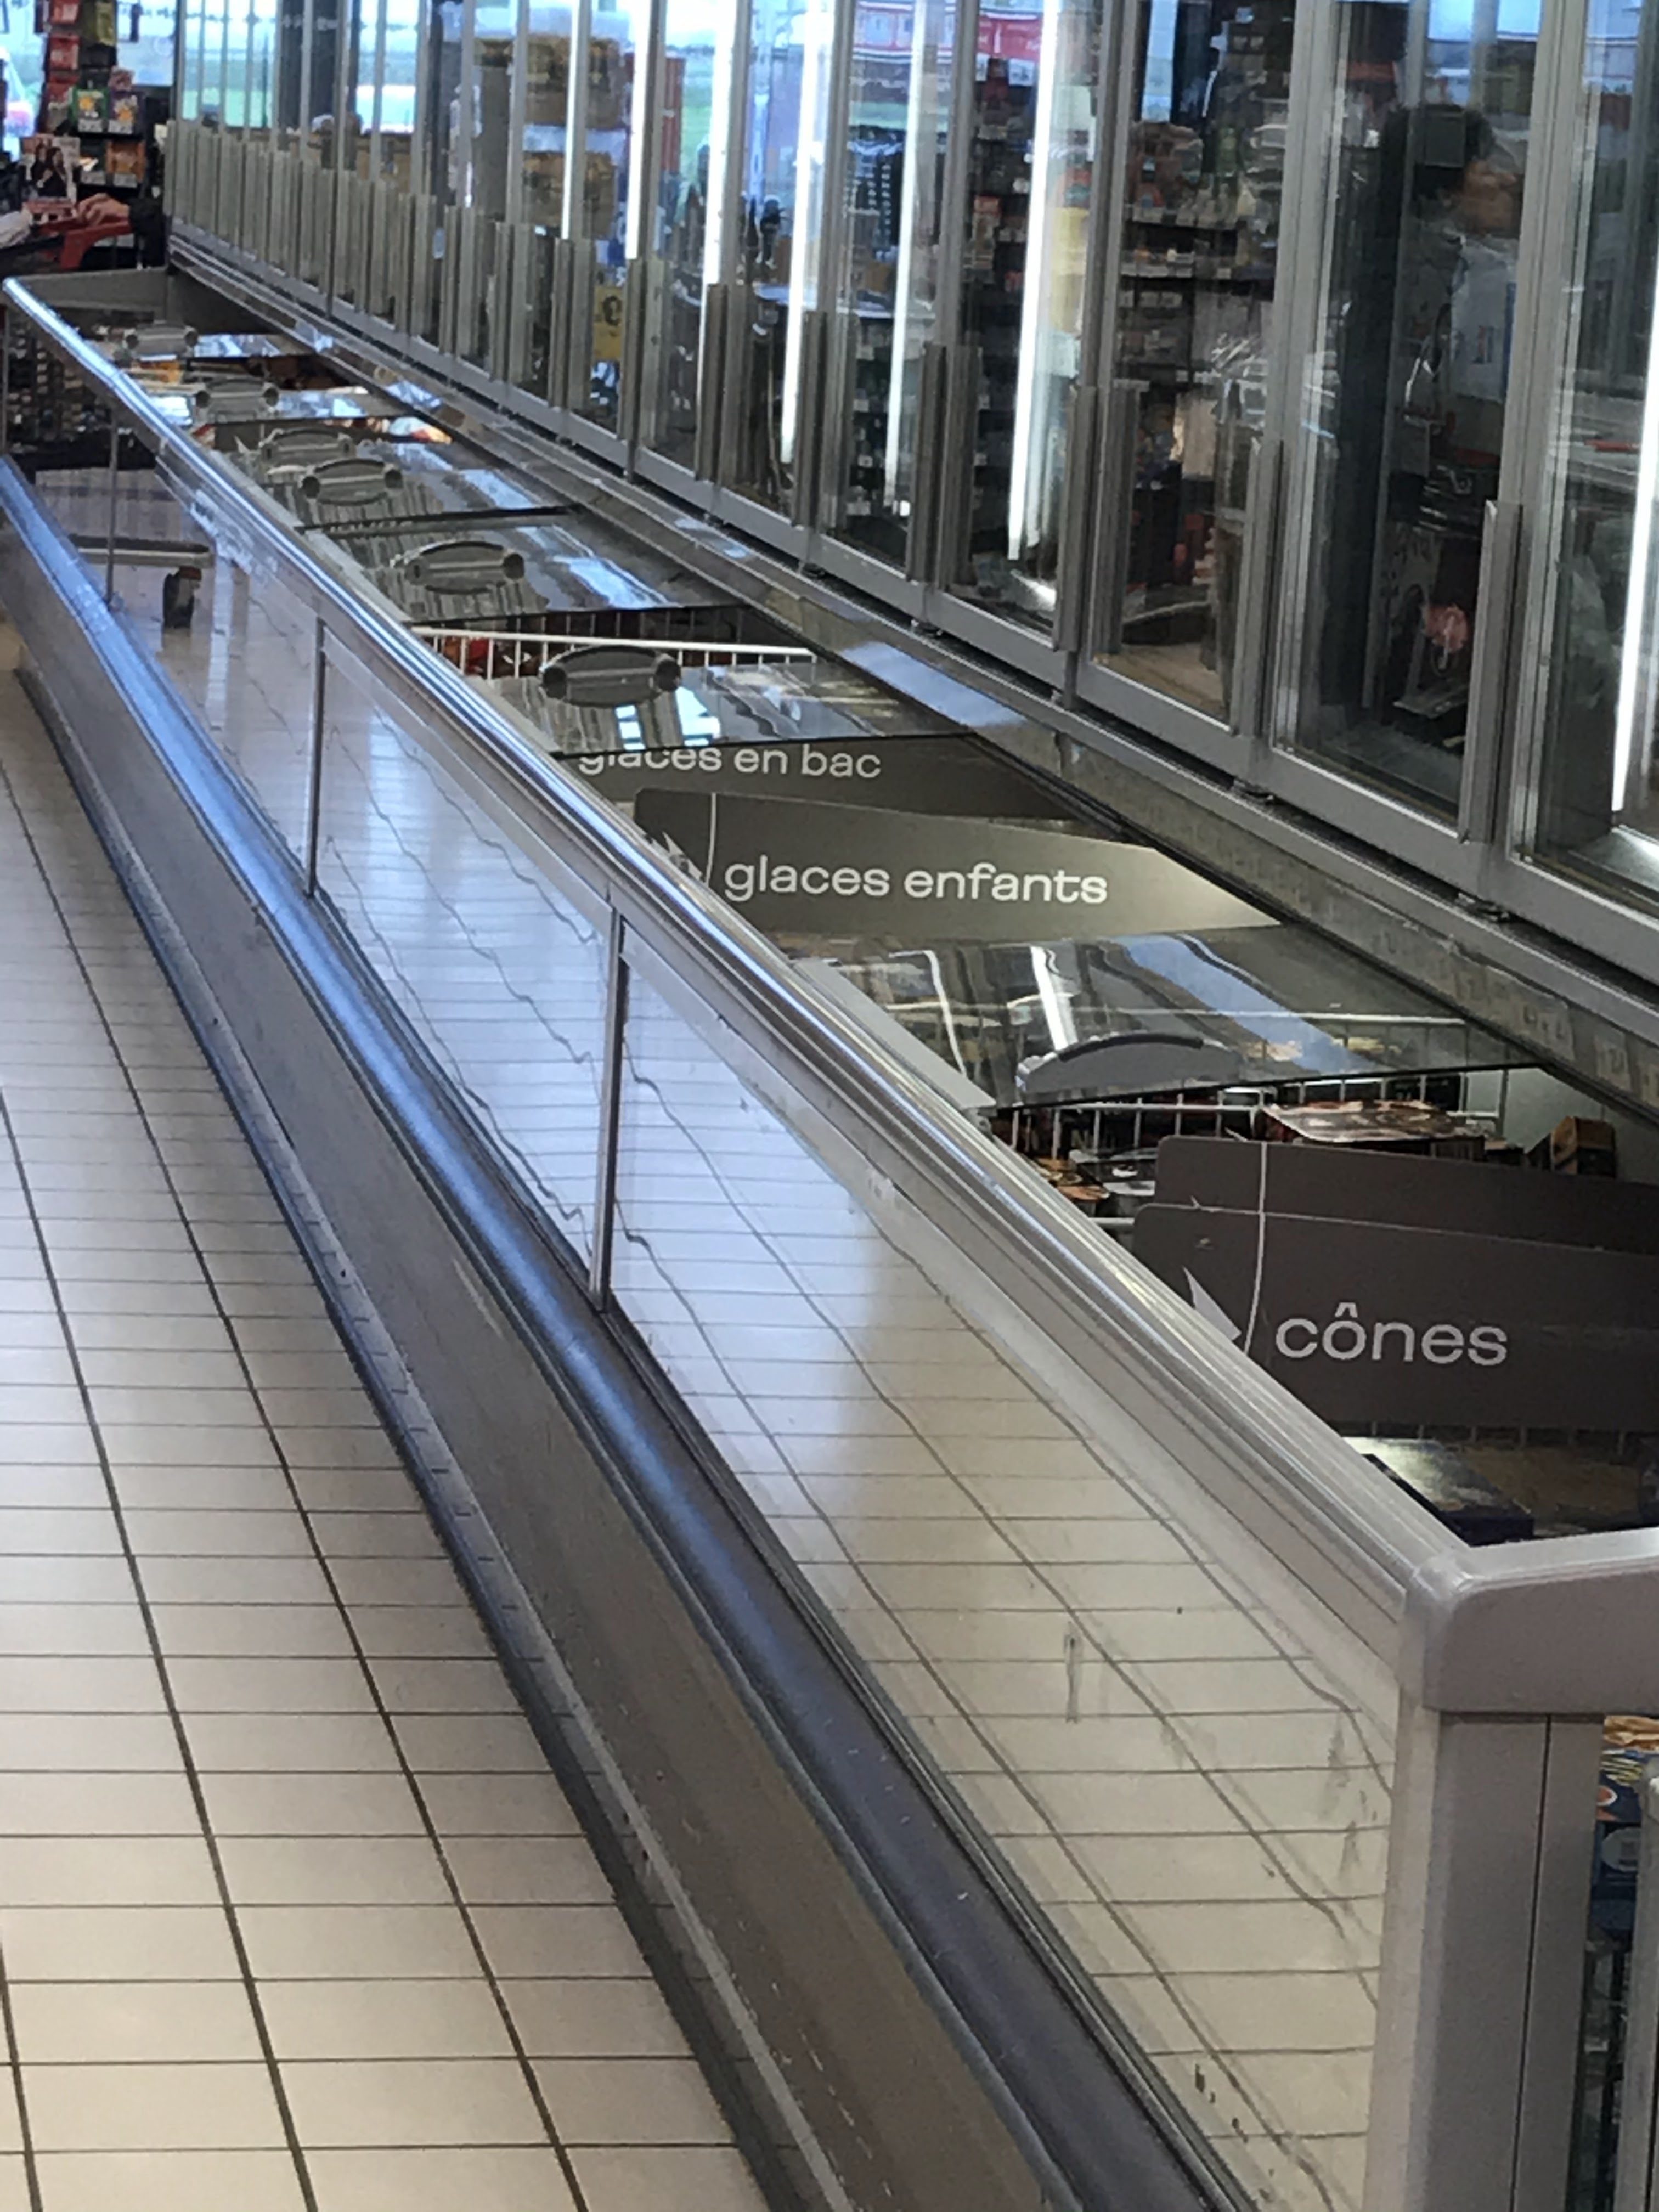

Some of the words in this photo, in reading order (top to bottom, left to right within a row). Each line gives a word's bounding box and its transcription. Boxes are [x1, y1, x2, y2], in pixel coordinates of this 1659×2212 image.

[733, 748, 788, 775] en
[801, 743, 881, 778] bac
[724, 855, 890, 902] glaces
[903, 862, 1108, 904] enfants
[1275, 1302, 1508, 1366] cônes
